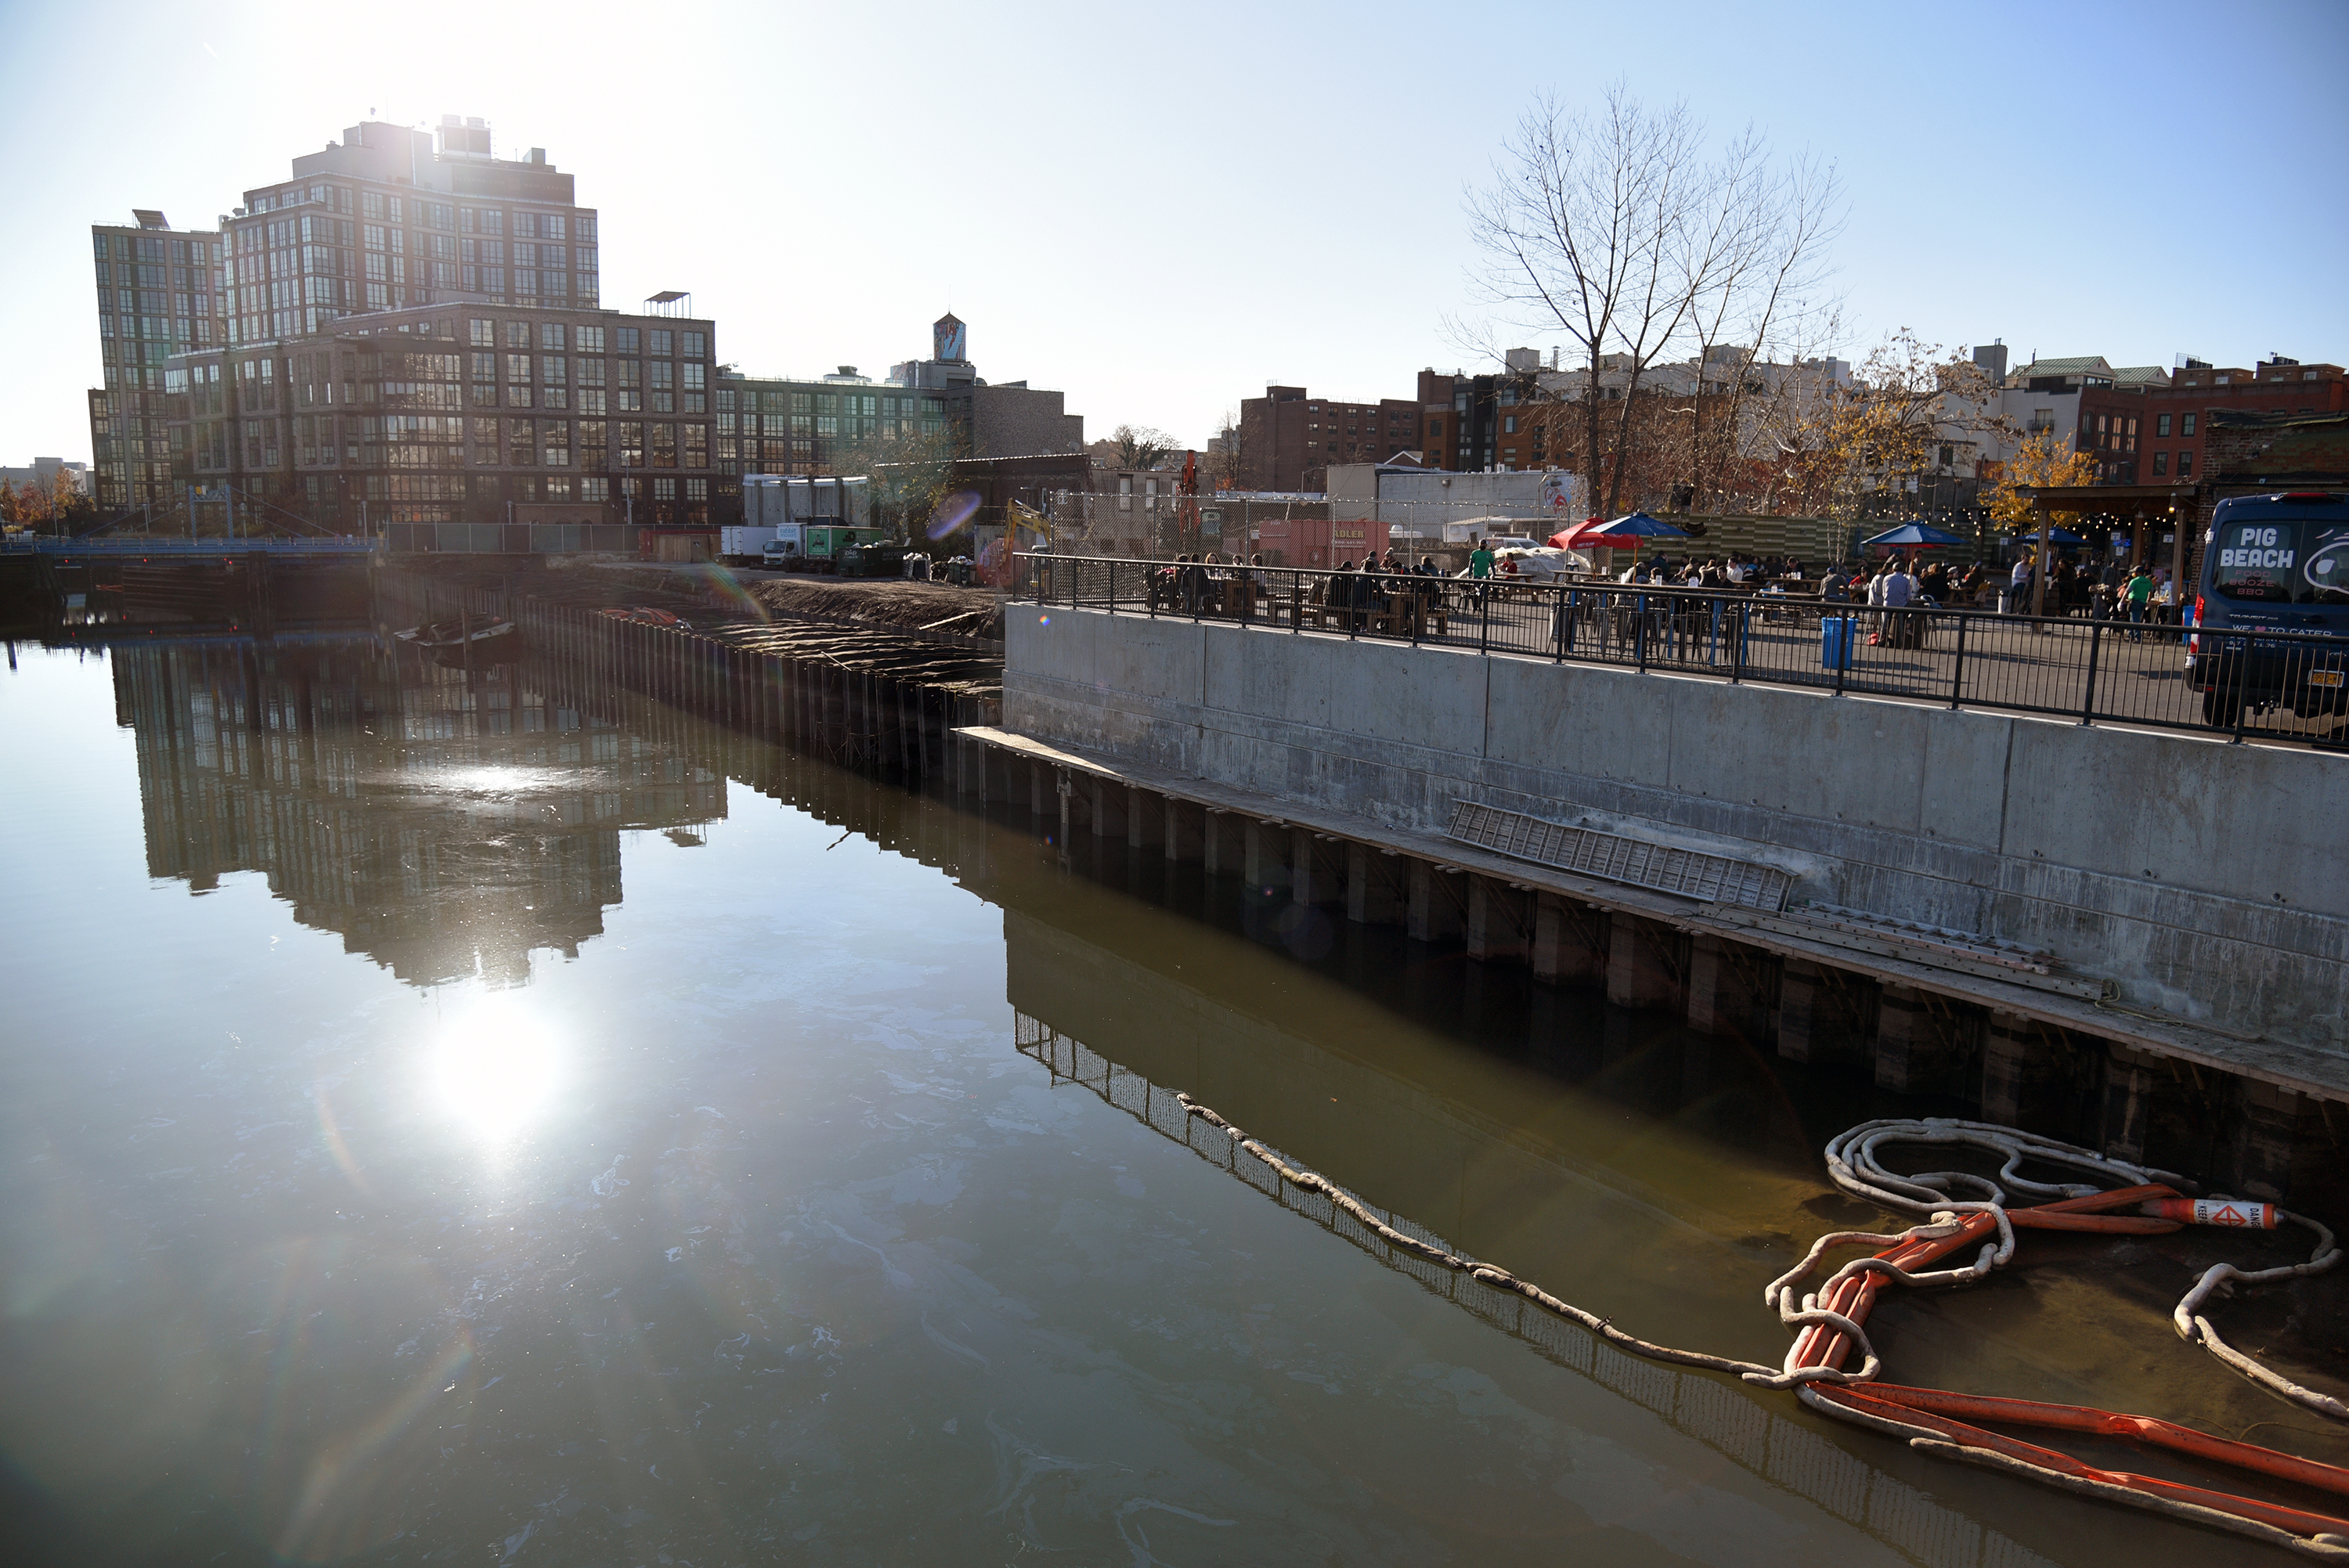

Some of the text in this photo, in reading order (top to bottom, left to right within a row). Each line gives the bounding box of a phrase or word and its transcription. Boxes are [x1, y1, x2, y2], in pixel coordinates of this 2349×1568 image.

[2240, 528, 2277, 546] PIG
[2220, 549, 2293, 568] BEACH
[2229, 579, 2275, 587] BOOZE
[2289, 628, 2333, 636] CATER
[2198, 1206, 2207, 1221] KEEP
